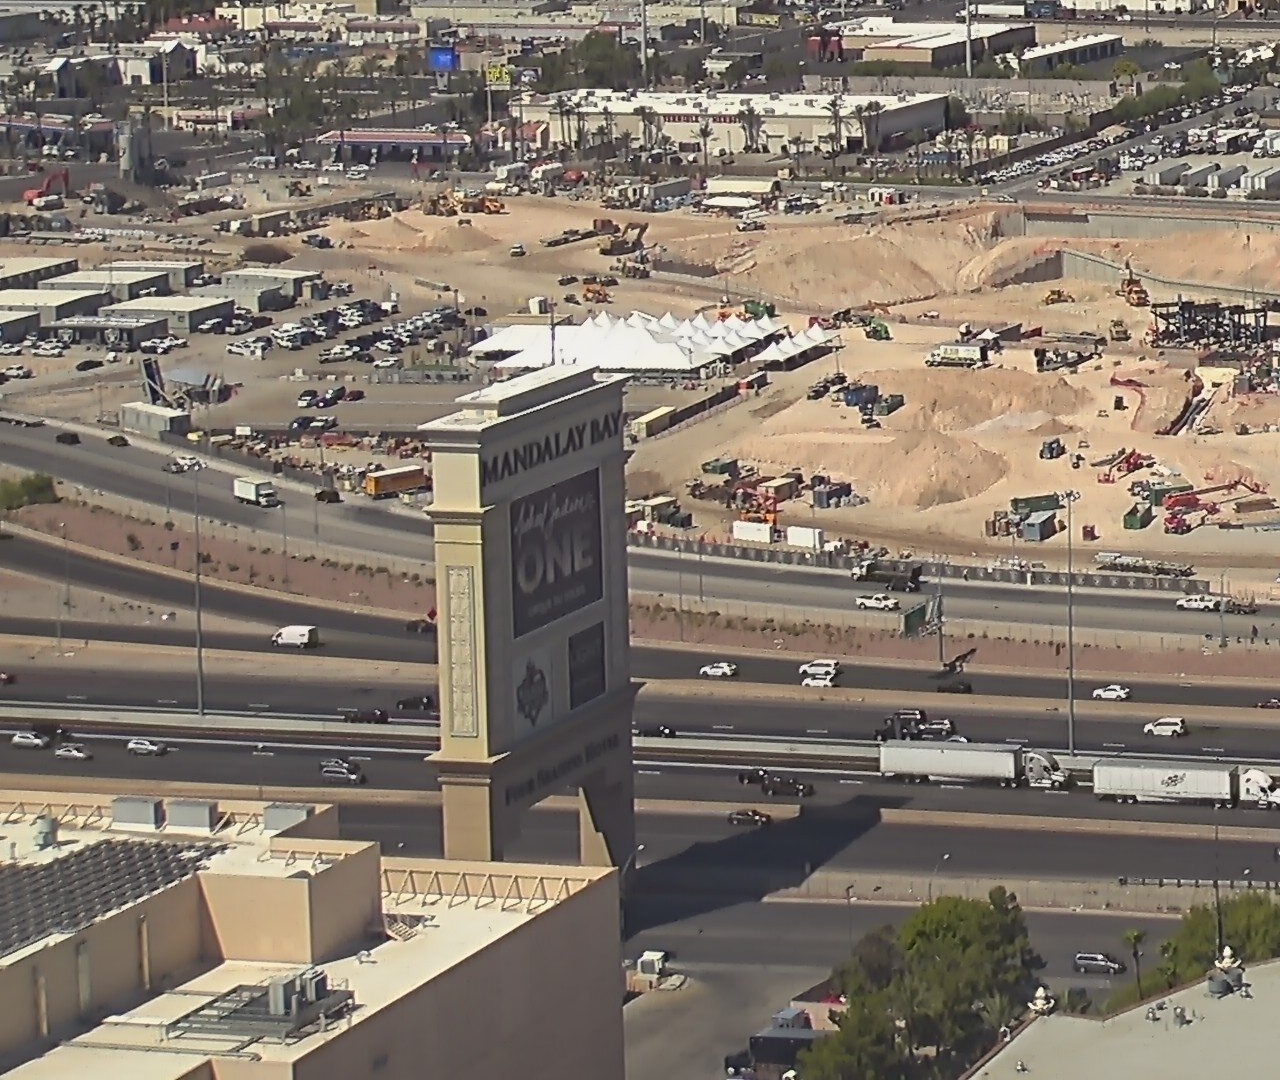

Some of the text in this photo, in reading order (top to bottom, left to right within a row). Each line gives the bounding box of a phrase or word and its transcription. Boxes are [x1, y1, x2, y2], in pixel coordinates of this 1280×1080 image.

[482, 410, 623, 488] MANDALAY BAY
[516, 527, 594, 594] ONE
